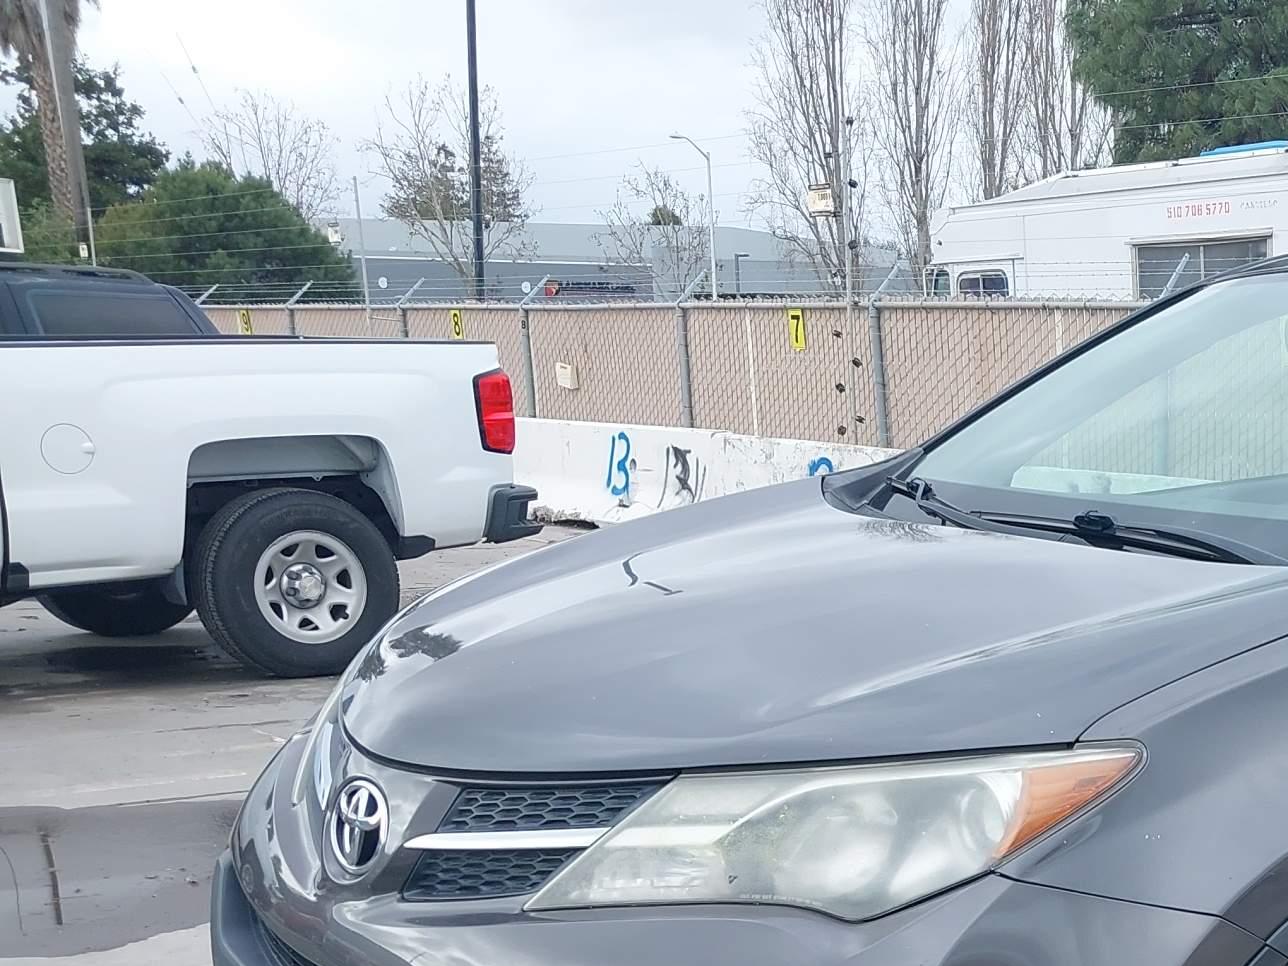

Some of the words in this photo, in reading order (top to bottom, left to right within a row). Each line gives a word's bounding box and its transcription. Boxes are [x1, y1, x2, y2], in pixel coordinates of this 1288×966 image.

[1167, 206, 1182, 218] 510
[1185, 204, 1203, 216] 706
[1205, 201, 1230, 215] 5770
[452, 312, 461, 337] 8
[790, 314, 801, 344] 7
